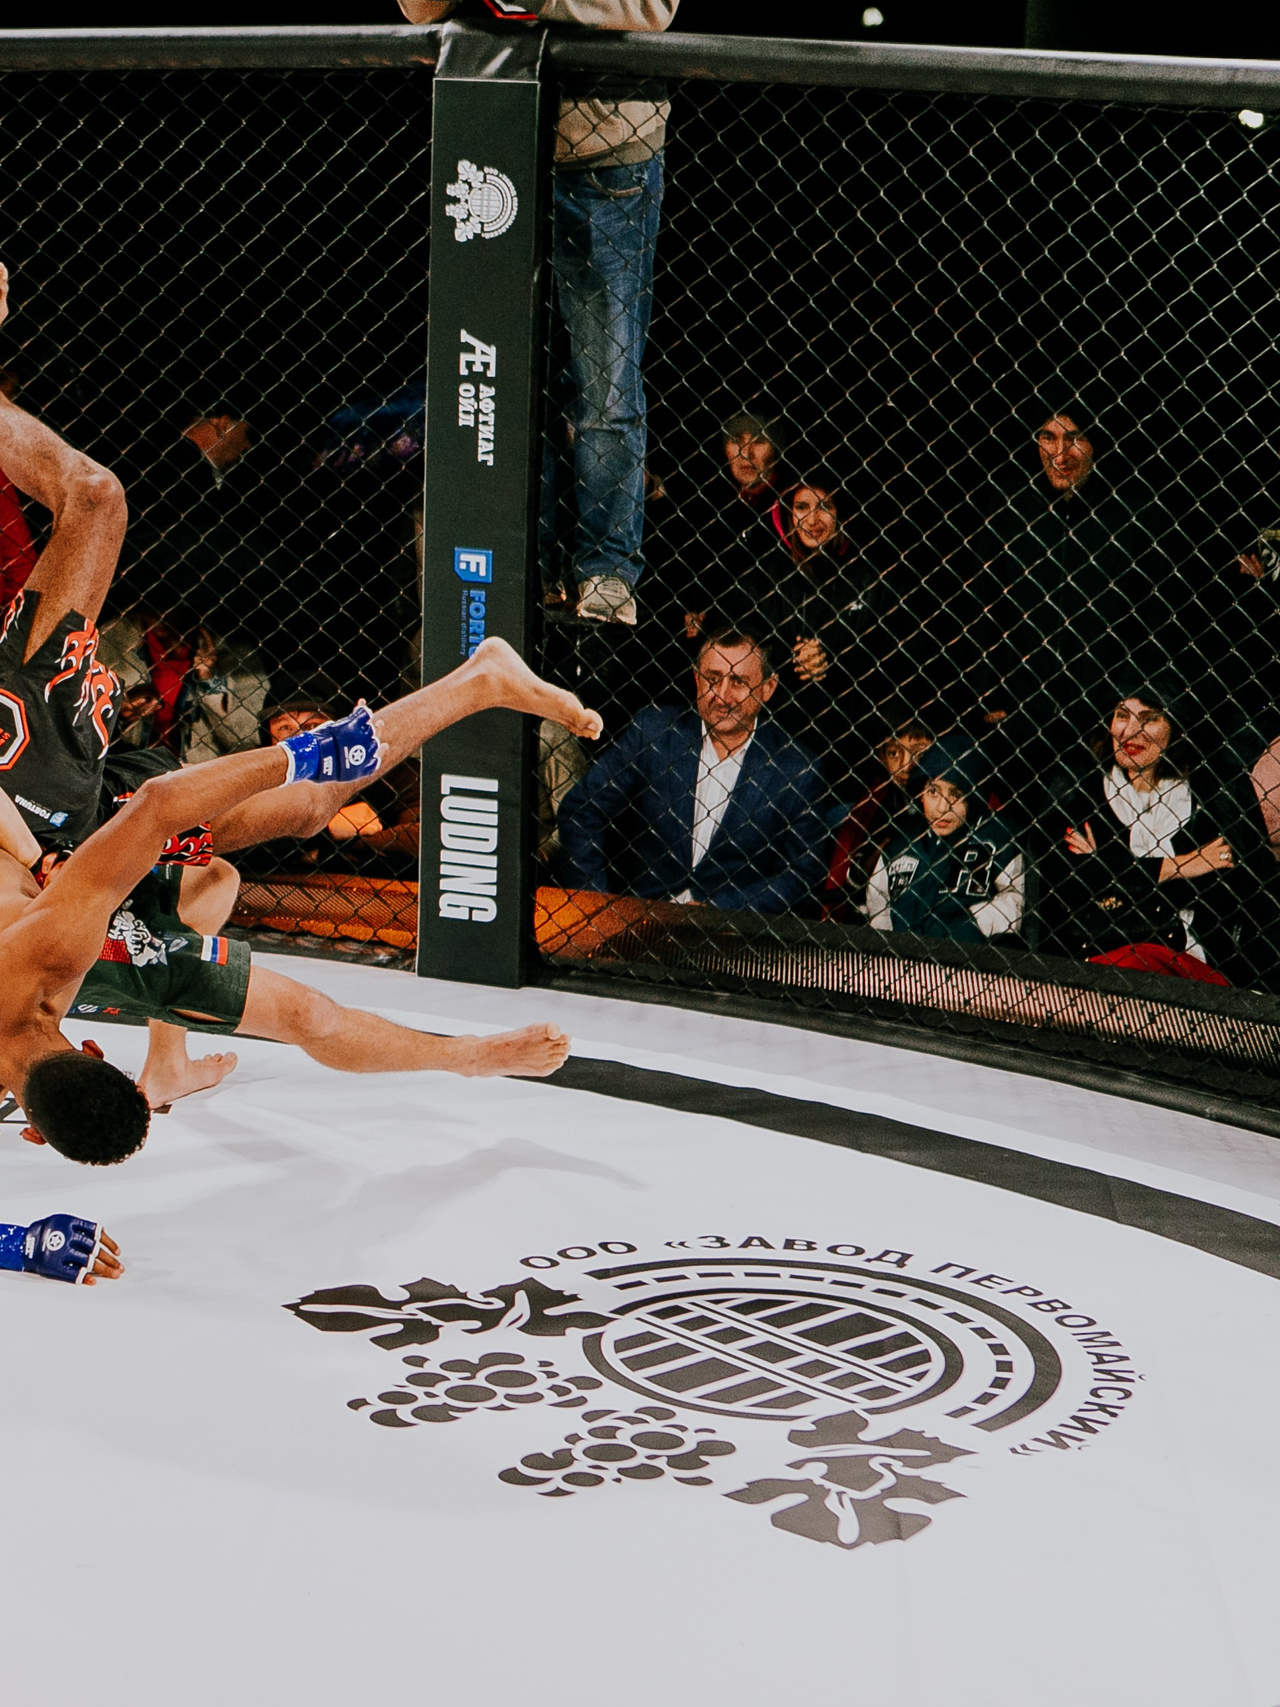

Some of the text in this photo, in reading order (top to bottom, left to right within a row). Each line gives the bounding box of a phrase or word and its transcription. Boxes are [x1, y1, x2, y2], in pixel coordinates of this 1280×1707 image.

[458, 383, 478, 427] ОЙЛ
[14, 794, 51, 819] FORTUNA
[438, 773, 499, 923] LUDING
[520, 1240, 638, 1270] ООО
[663, 1234, 915, 1269] «ЗАВОД
